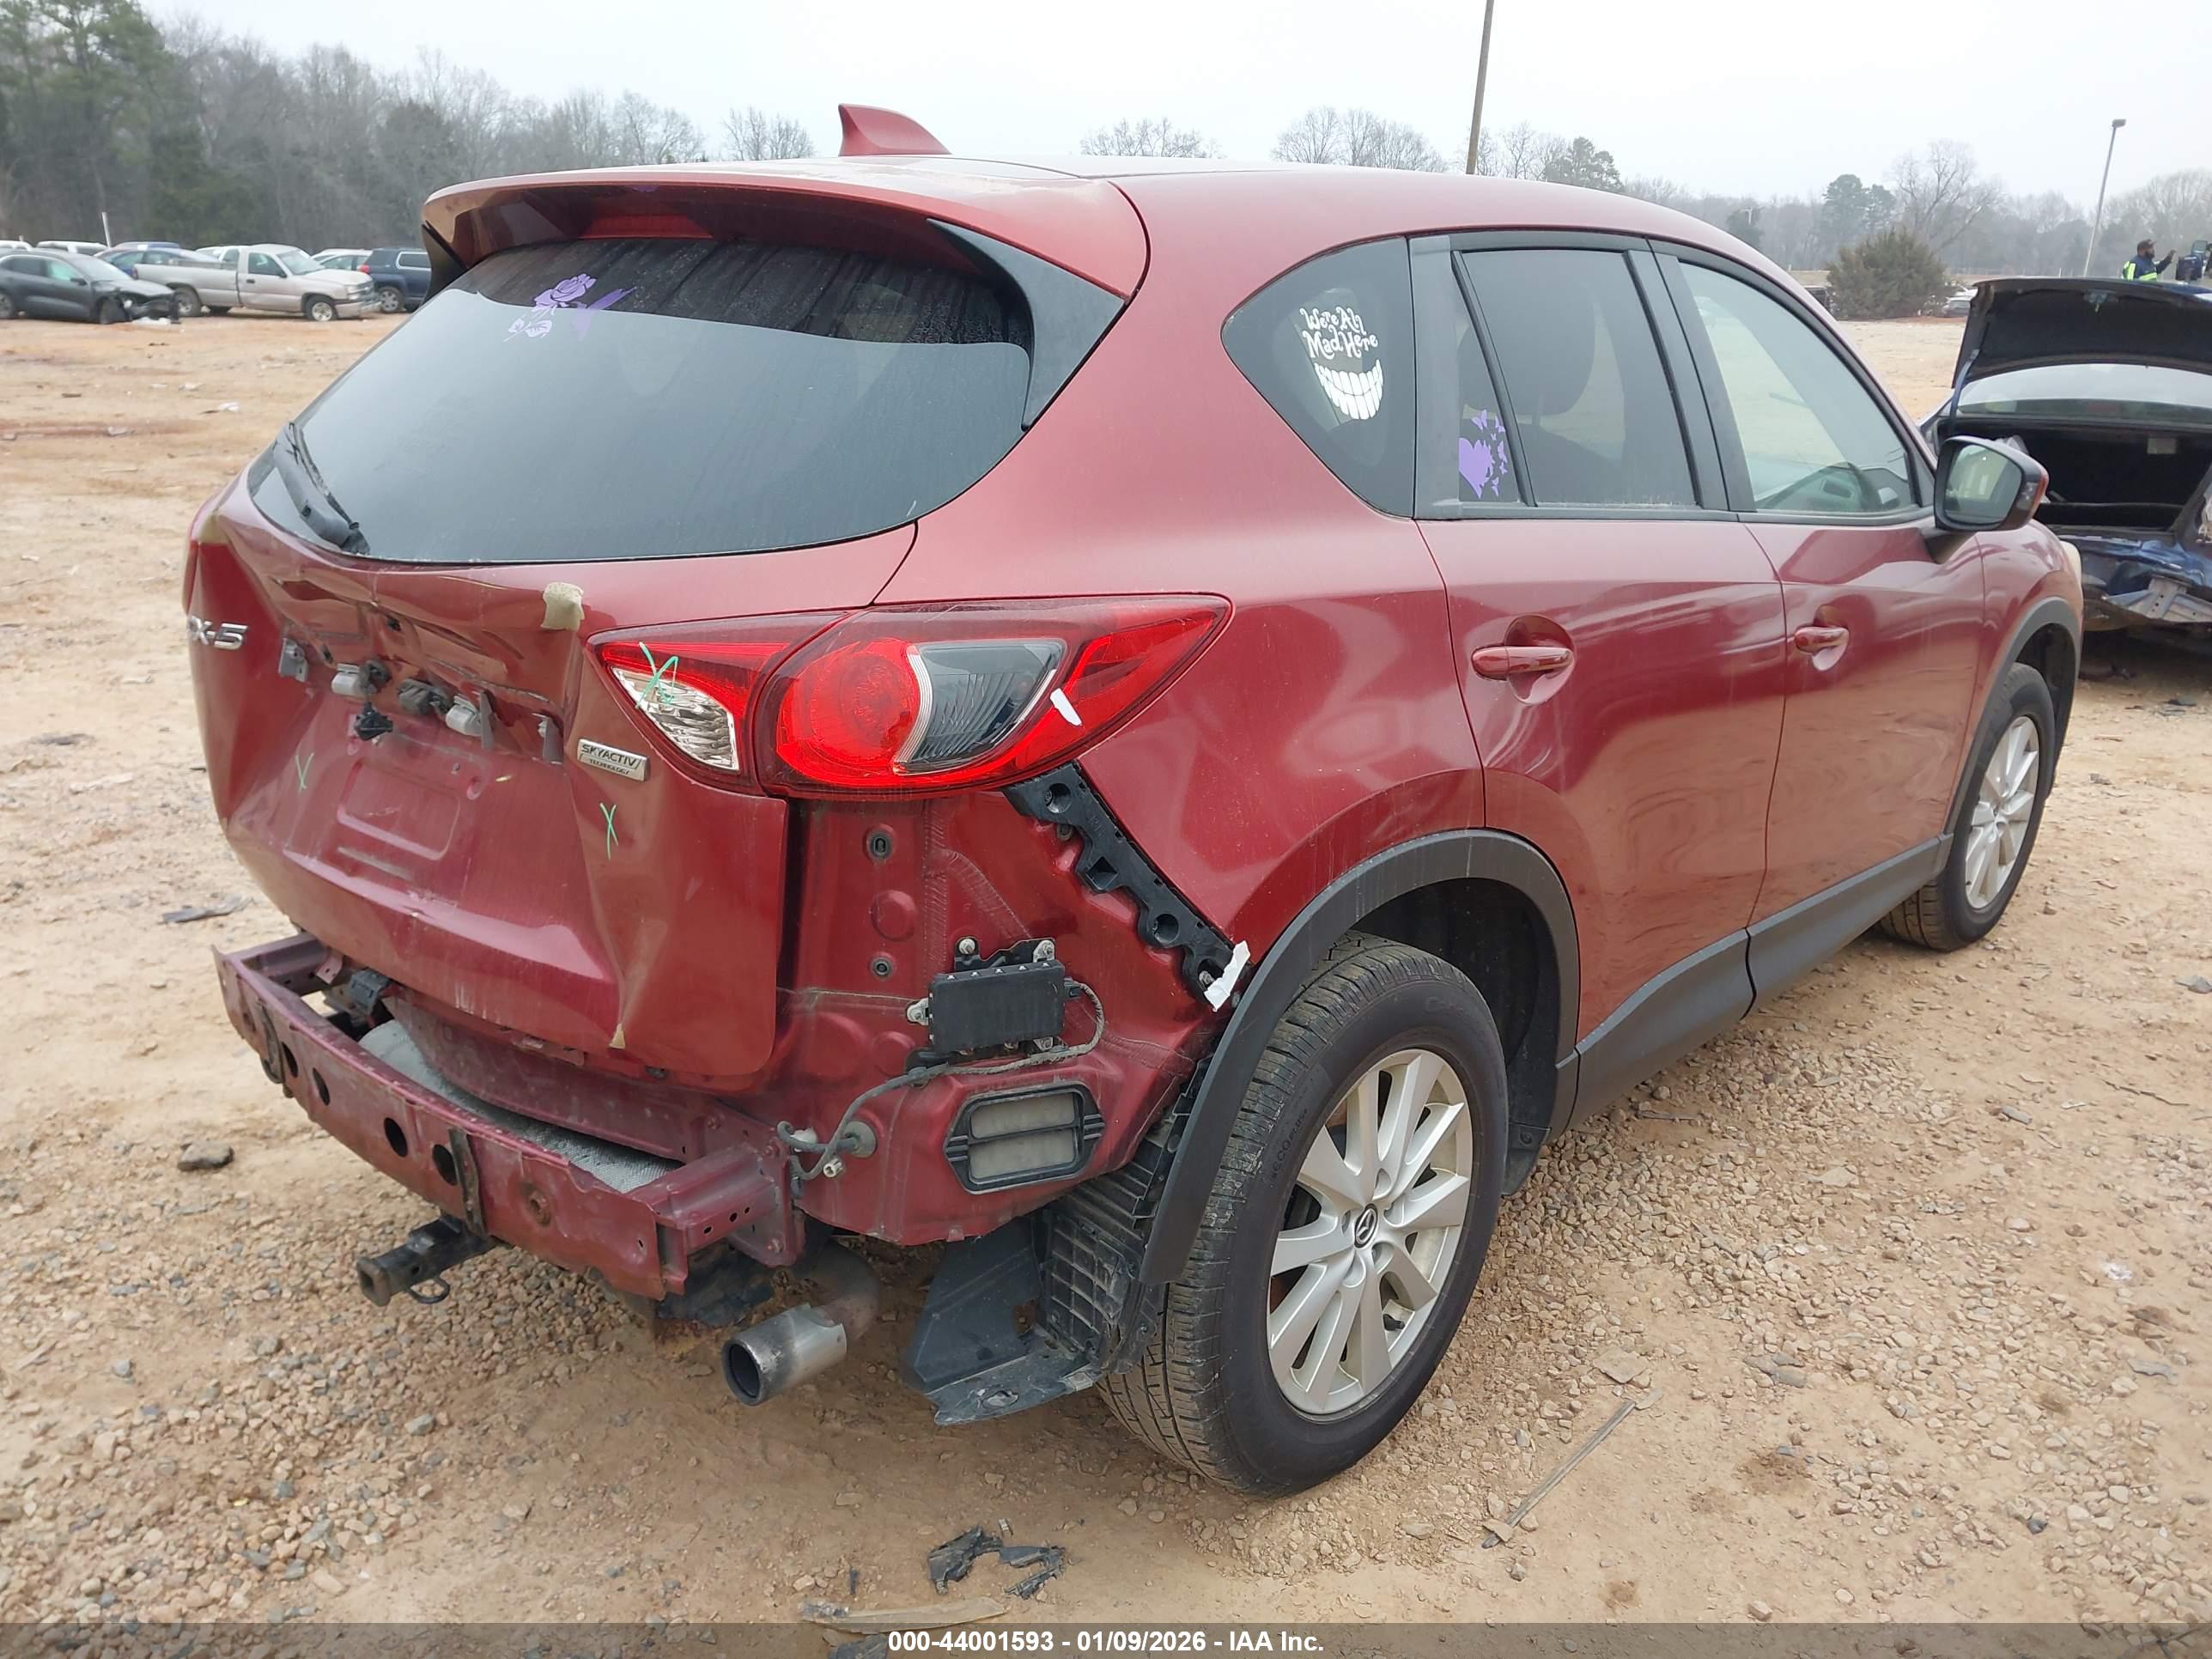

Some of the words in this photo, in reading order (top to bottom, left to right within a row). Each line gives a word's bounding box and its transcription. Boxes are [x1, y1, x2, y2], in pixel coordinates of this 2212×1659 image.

[1335, 306, 1367, 335] All
[1302, 325, 1342, 360] Mad
[1338, 330, 1378, 358] Here
[581, 744, 637, 767] SKYACTIV
